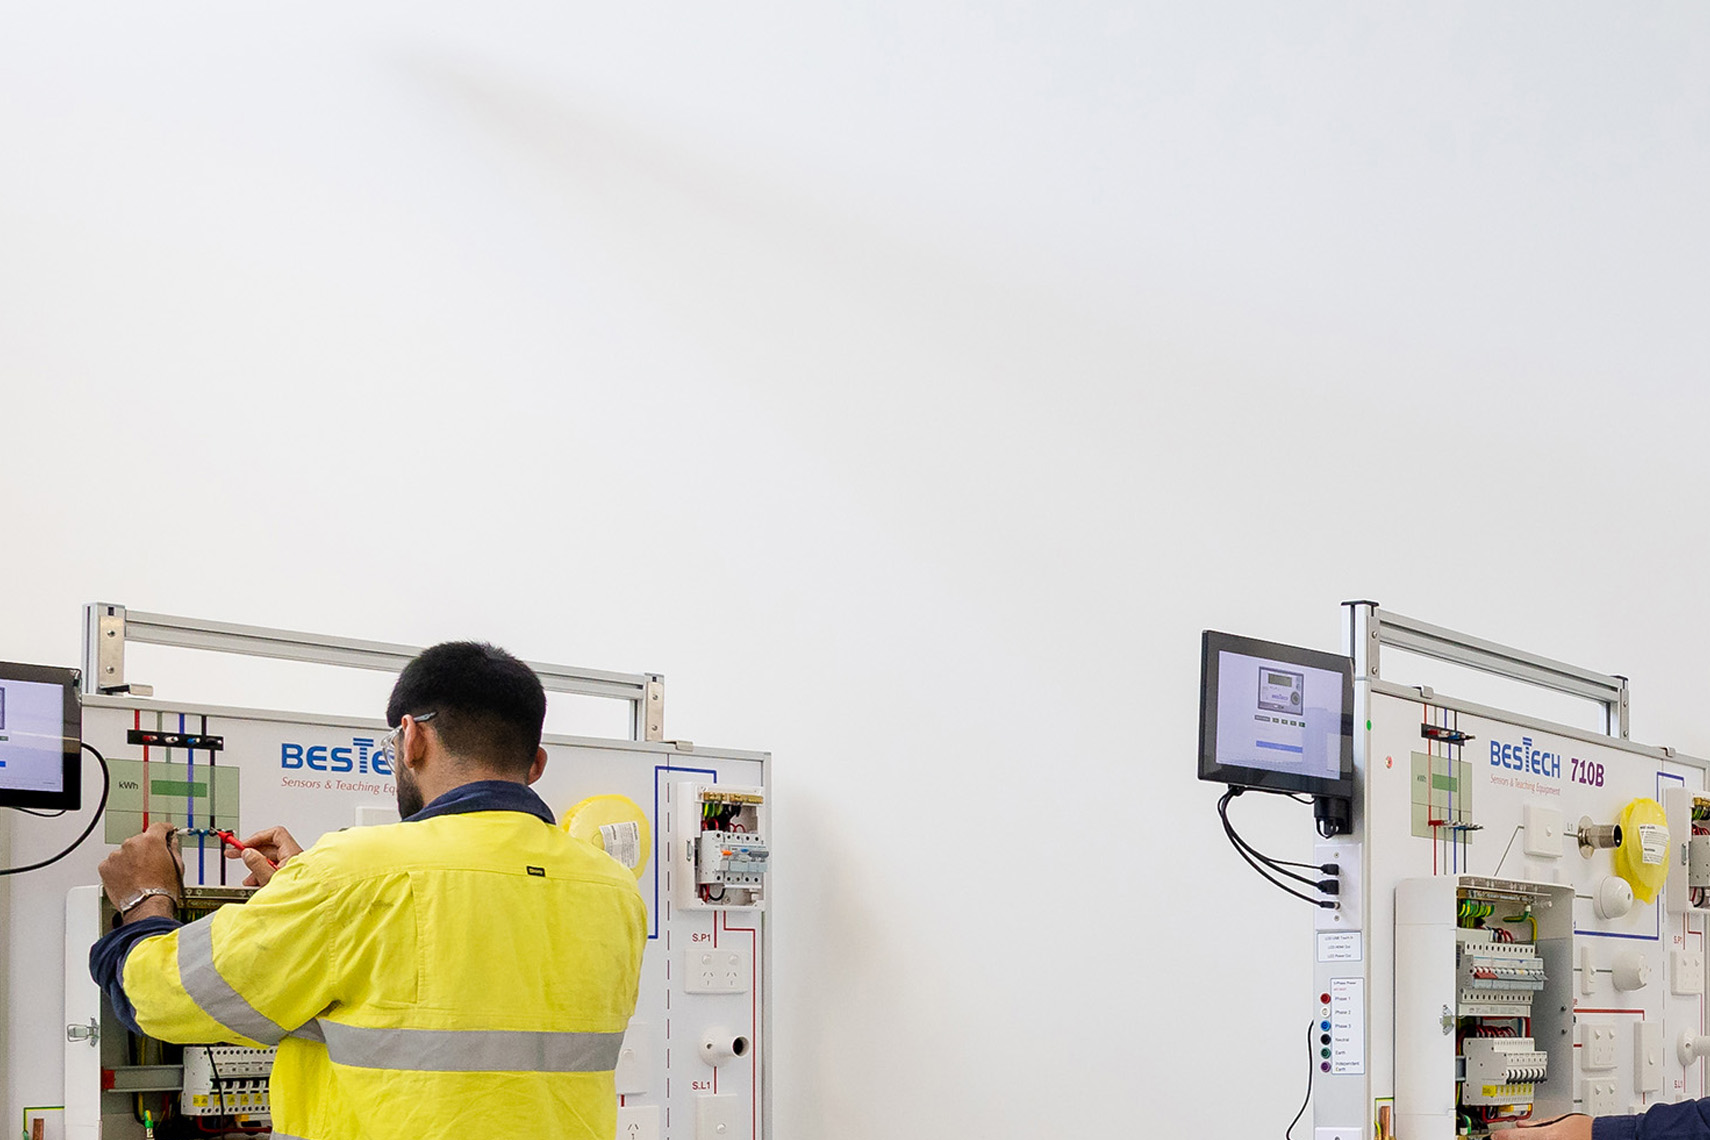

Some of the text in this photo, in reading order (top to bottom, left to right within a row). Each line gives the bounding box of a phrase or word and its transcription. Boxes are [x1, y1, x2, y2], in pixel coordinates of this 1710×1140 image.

[281, 737, 393, 776] BESTE
[1490, 737, 1605, 787] BESTECH 710B
[119, 781, 139, 790] kWh
[281, 776, 321, 788] Sensors
[324, 780, 332, 789] &
[336, 780, 380, 796] Teaching
[1490, 773, 1509, 786] Sensors
[1515, 778, 1536, 795] Teaching
[1536, 782, 1560, 797] Equipment
[692, 933, 711, 943] S.P1
[692, 1080, 711, 1090] S.L1
